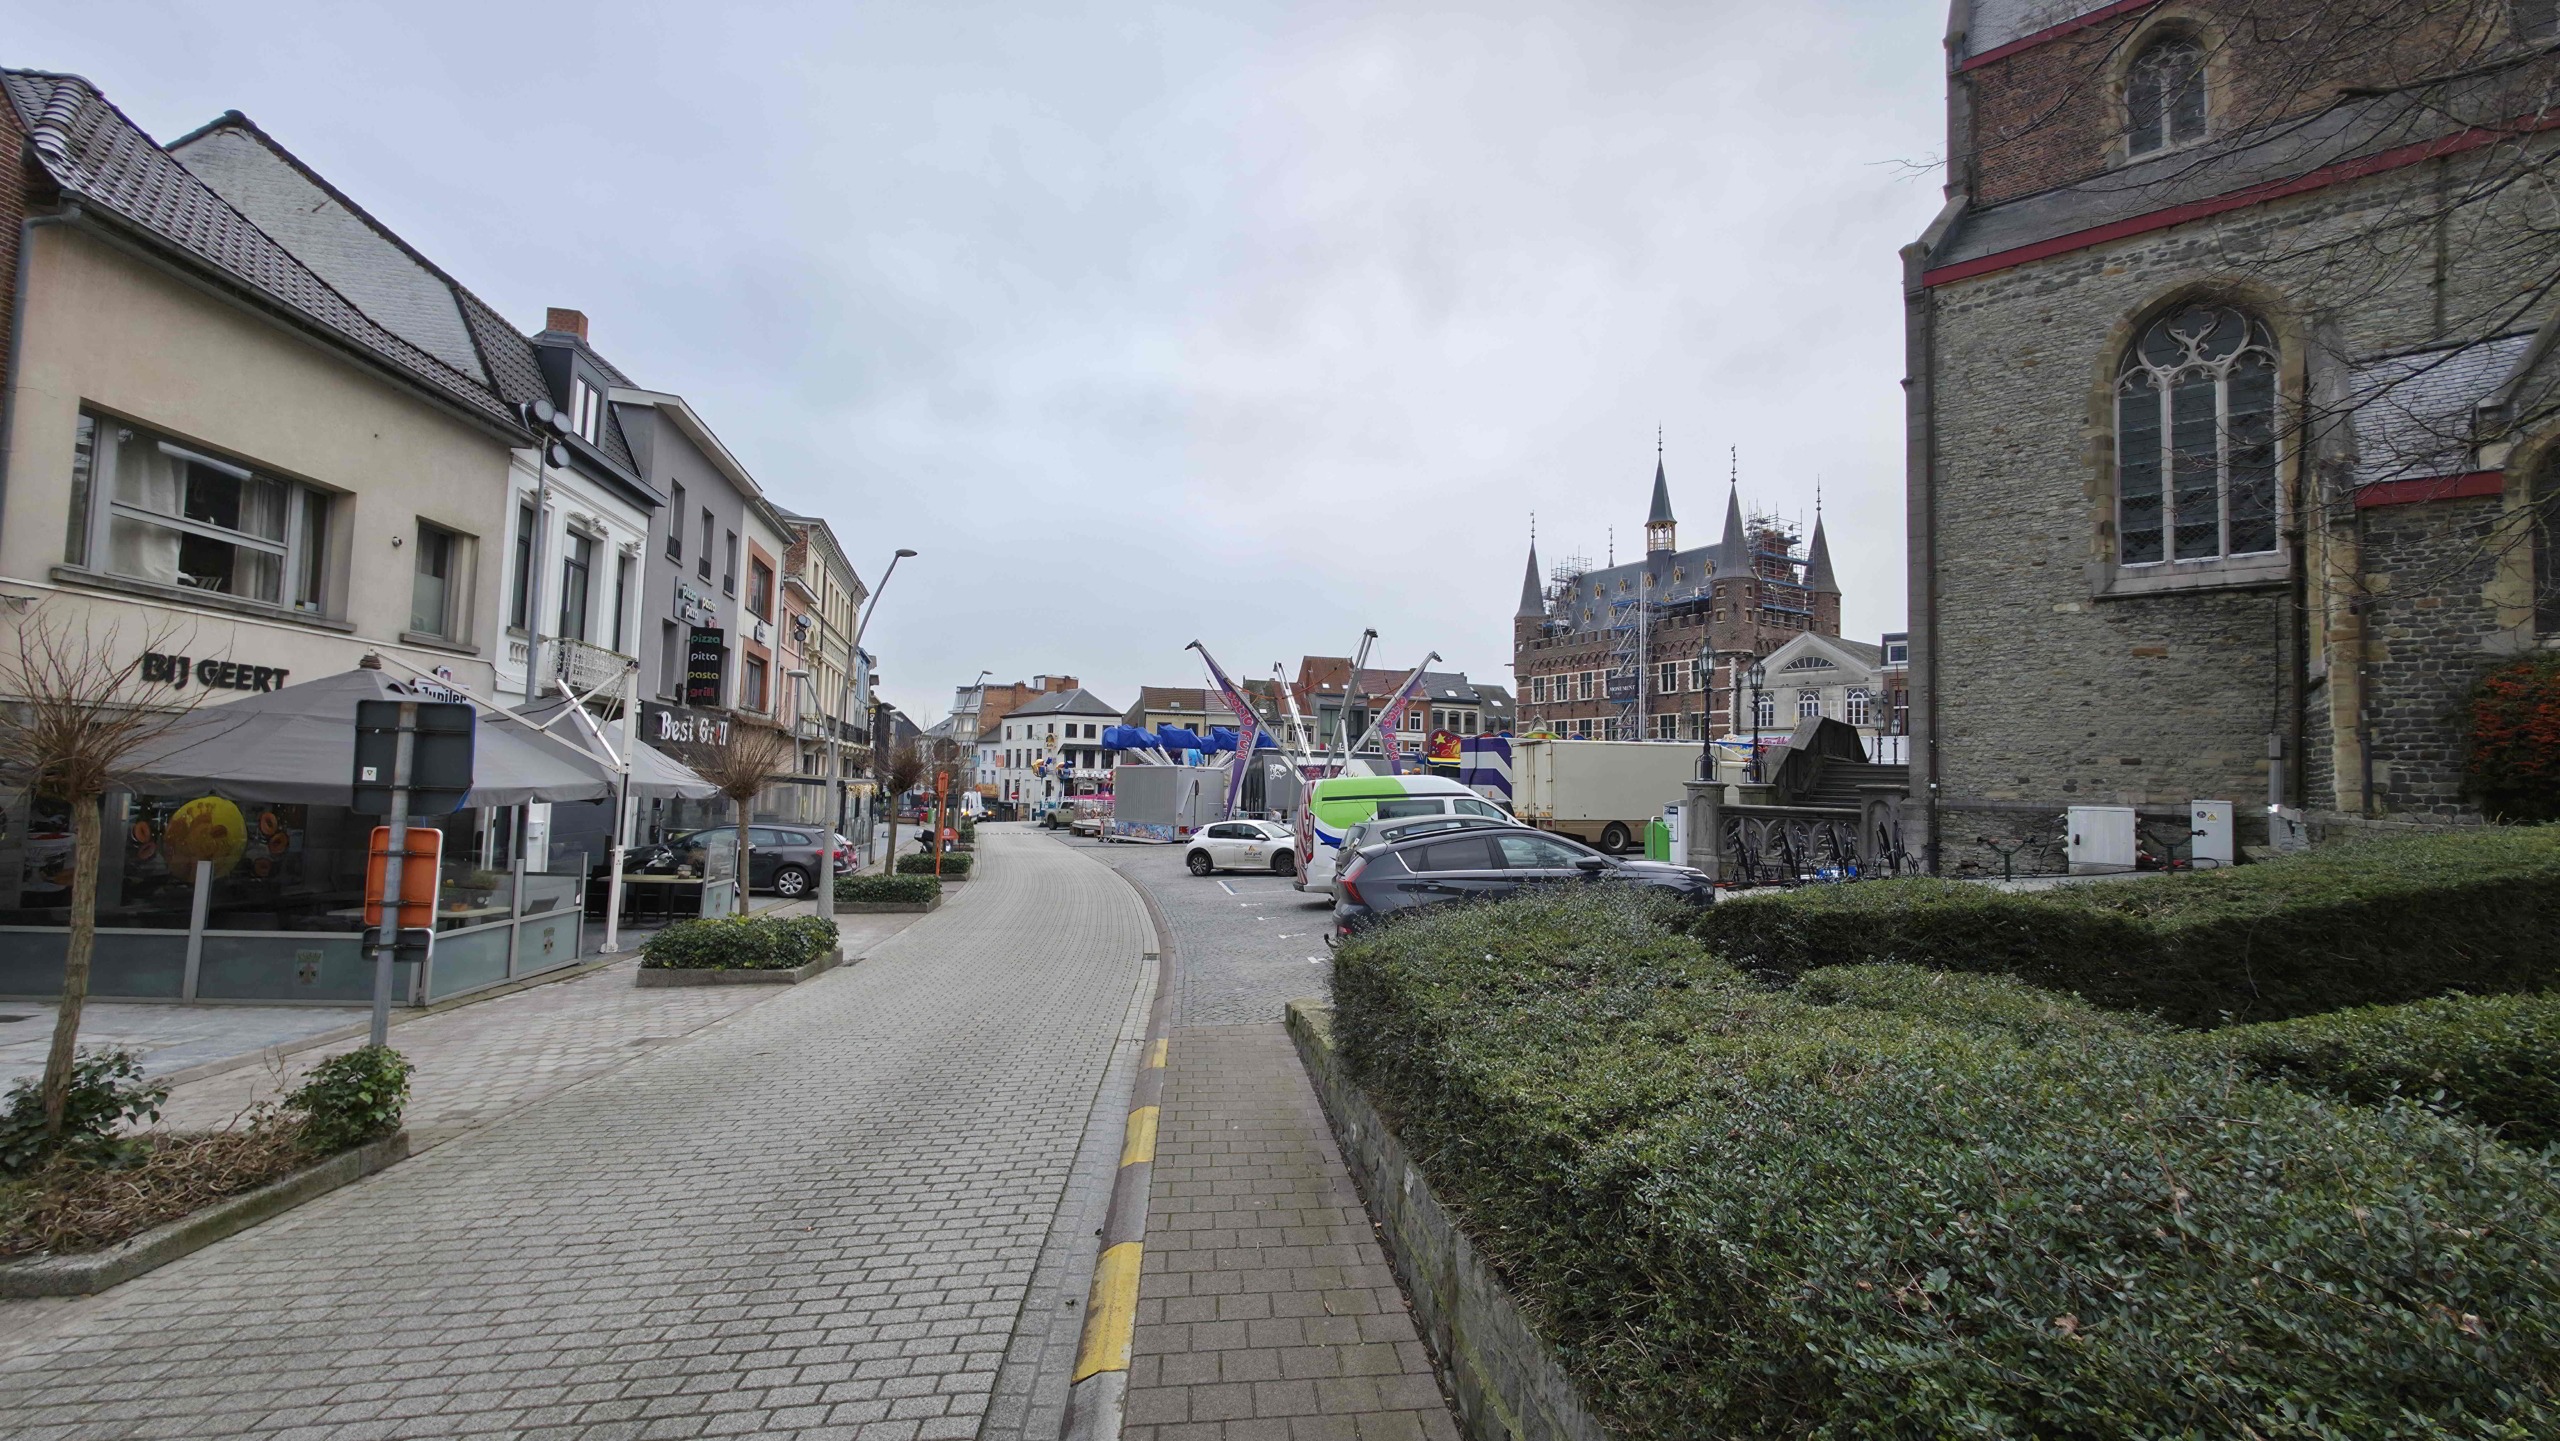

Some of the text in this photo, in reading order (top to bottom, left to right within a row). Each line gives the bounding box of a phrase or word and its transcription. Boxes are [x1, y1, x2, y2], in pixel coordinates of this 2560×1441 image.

[691, 634, 721, 644] pizza
[691, 651, 718, 662] pitta
[142, 652, 290, 694] BIJ GEERT
[688, 671, 719, 680] pasta
[688, 687, 715, 698] grill
[660, 710, 694, 742] Best
[1235, 730, 1253, 761] FUN
